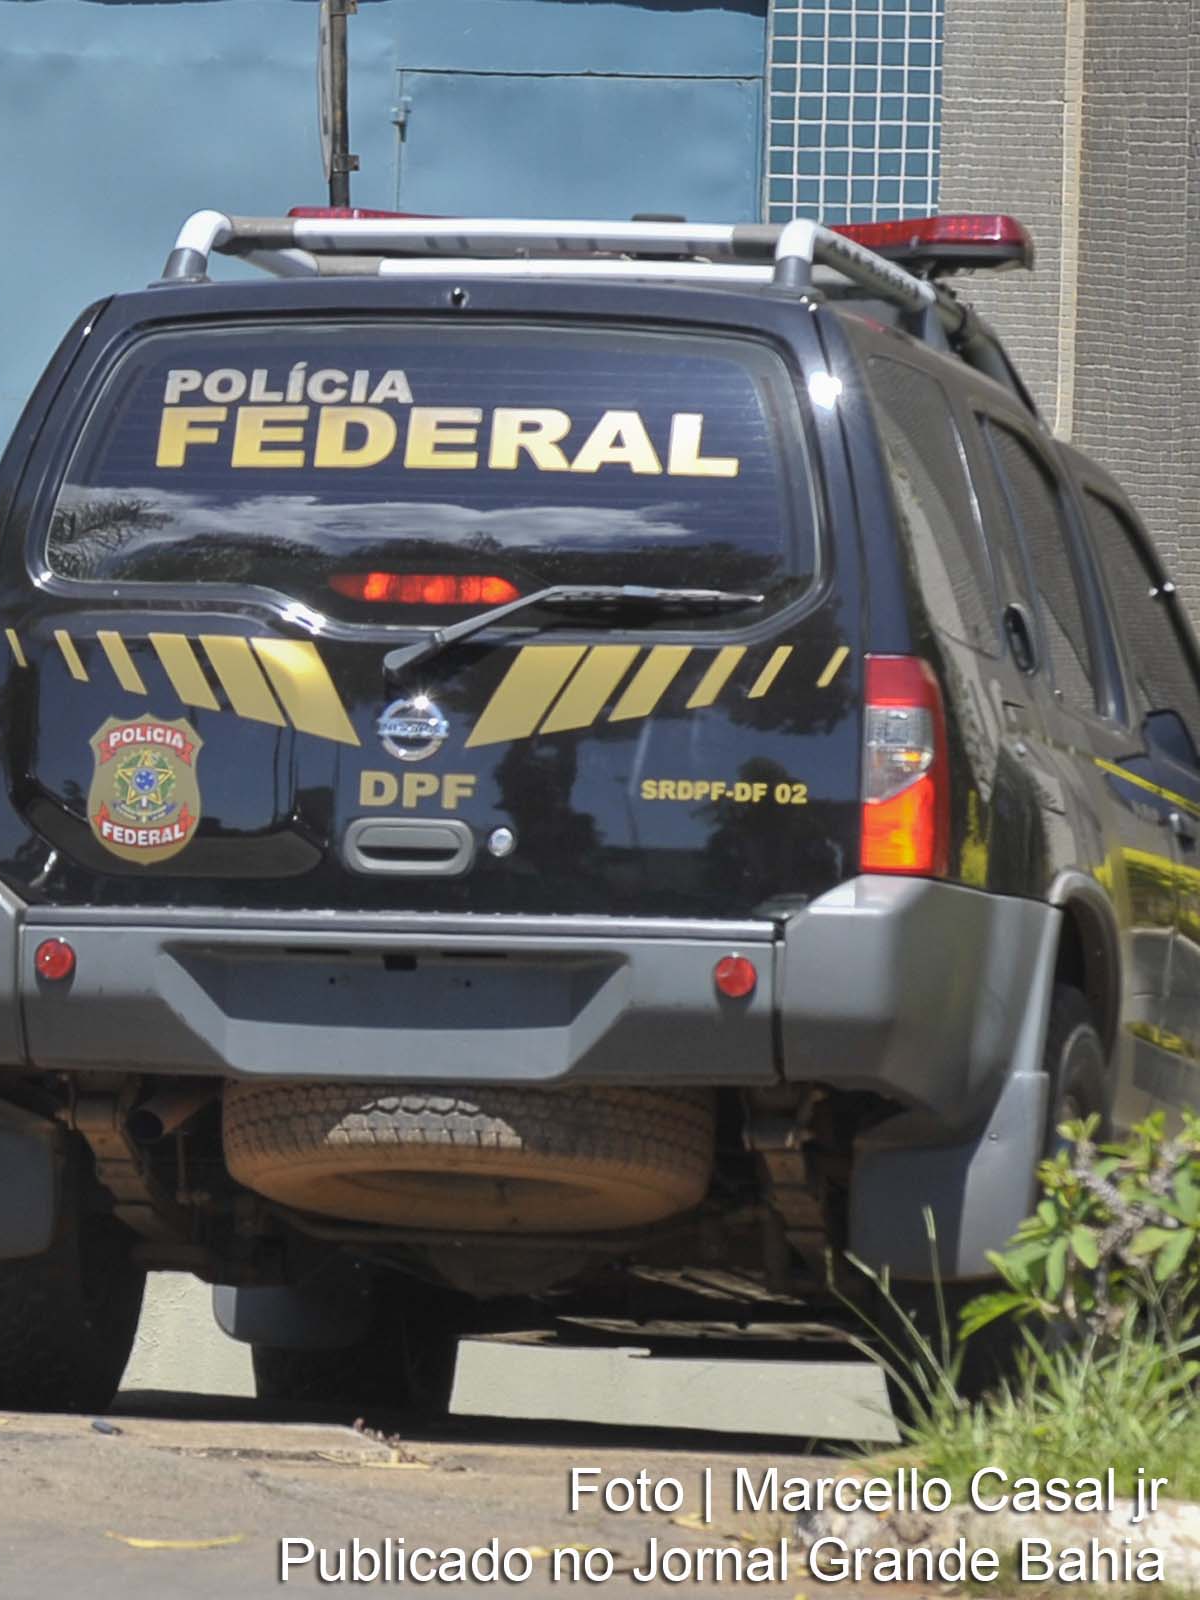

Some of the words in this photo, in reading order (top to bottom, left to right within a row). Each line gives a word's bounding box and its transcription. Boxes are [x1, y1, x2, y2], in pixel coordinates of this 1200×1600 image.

[163, 362, 414, 403] POLÍCIA
[155, 405, 739, 478] FEDERAL
[109, 726, 184, 748] POLÍCIA
[359, 770, 476, 810] DPF
[641, 779, 768, 803] SRDPF-DF
[774, 783, 808, 805] 02
[102, 821, 185, 846] FEDERAL
